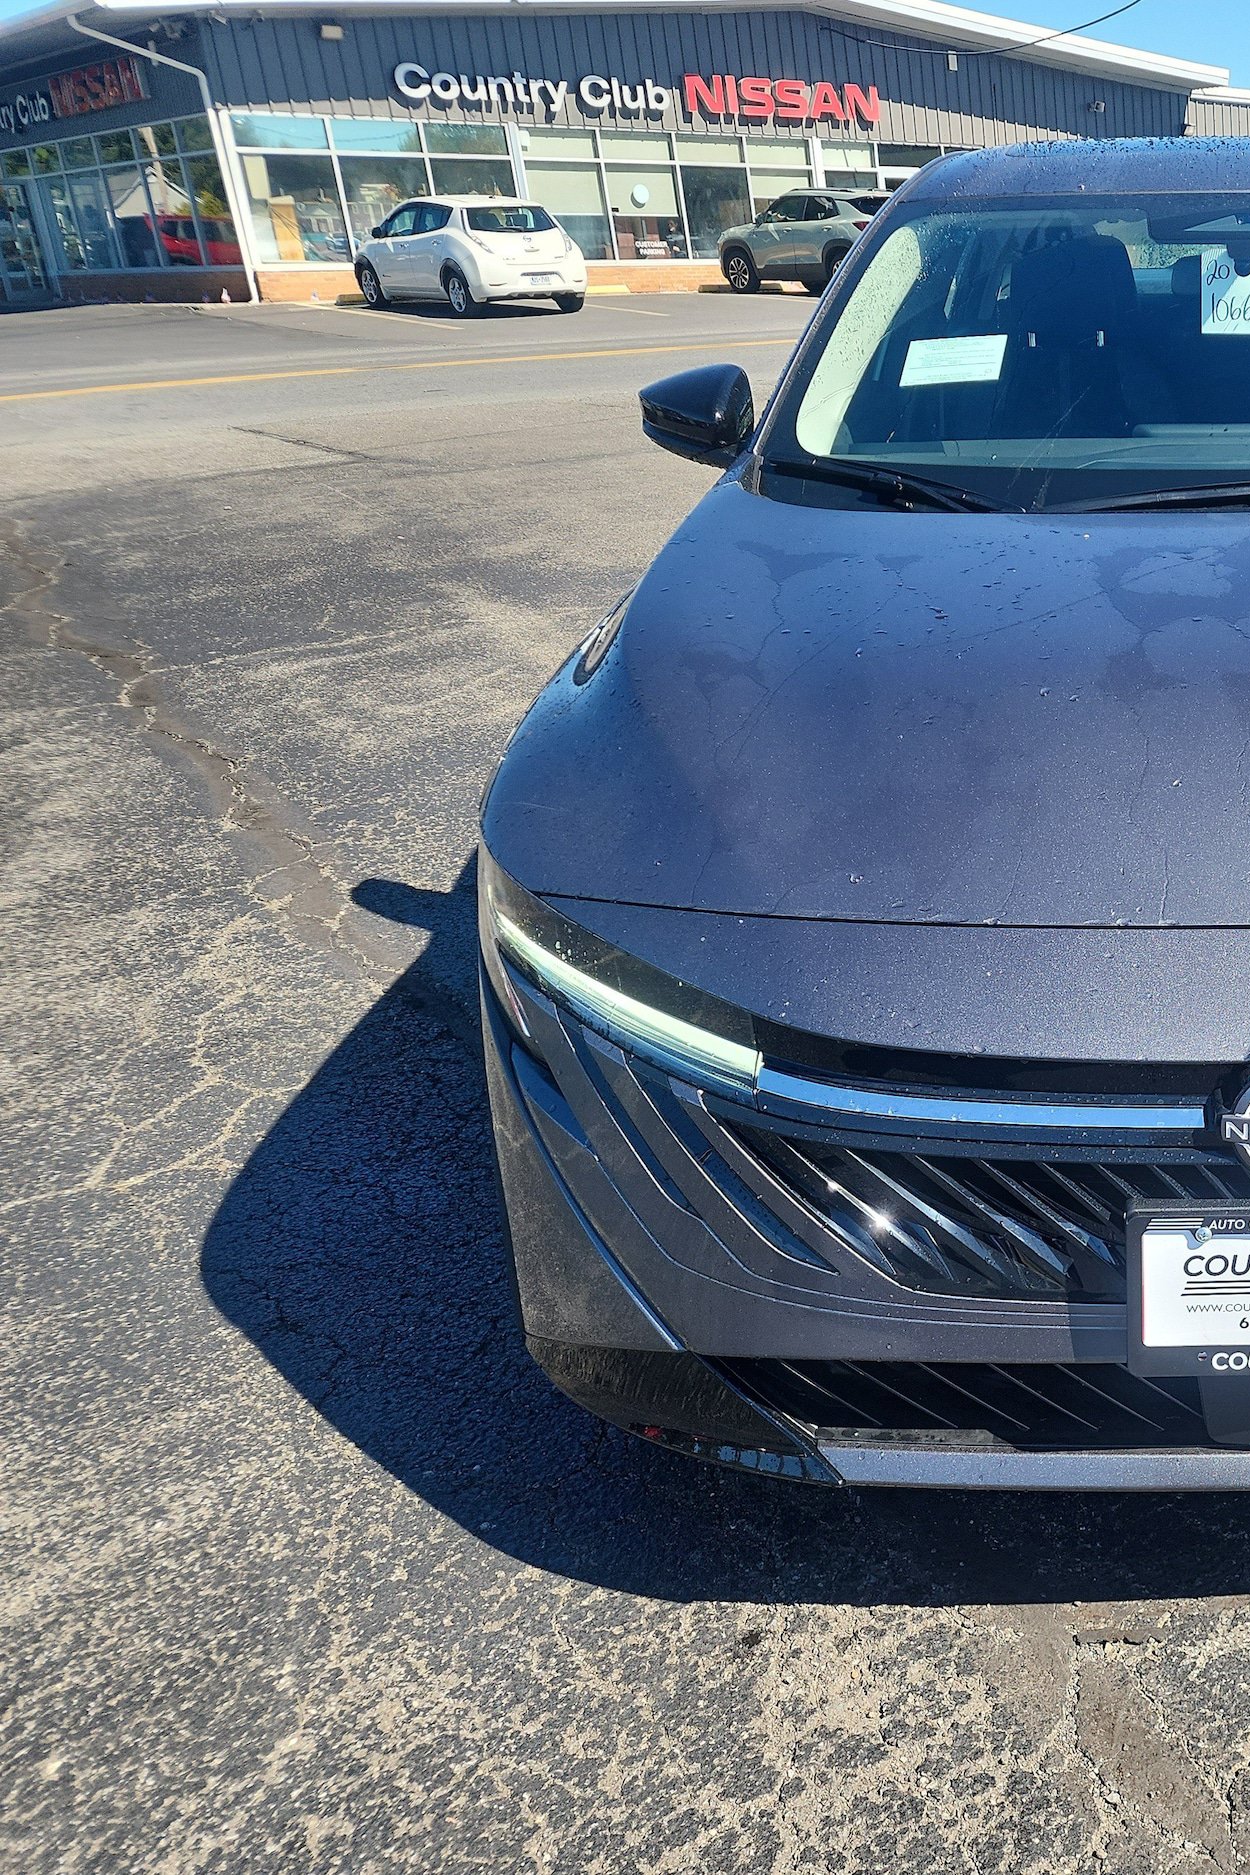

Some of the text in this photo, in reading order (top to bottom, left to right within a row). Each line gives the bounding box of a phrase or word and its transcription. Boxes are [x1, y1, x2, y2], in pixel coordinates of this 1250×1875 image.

[15, 90, 49, 125] Club
[48, 57, 144, 118] NISSAN
[394, 62, 881, 122] Country Club NISSAN
[1206, 259, 1230, 286] 20
[1208, 1218, 1245, 1231] AUTO
